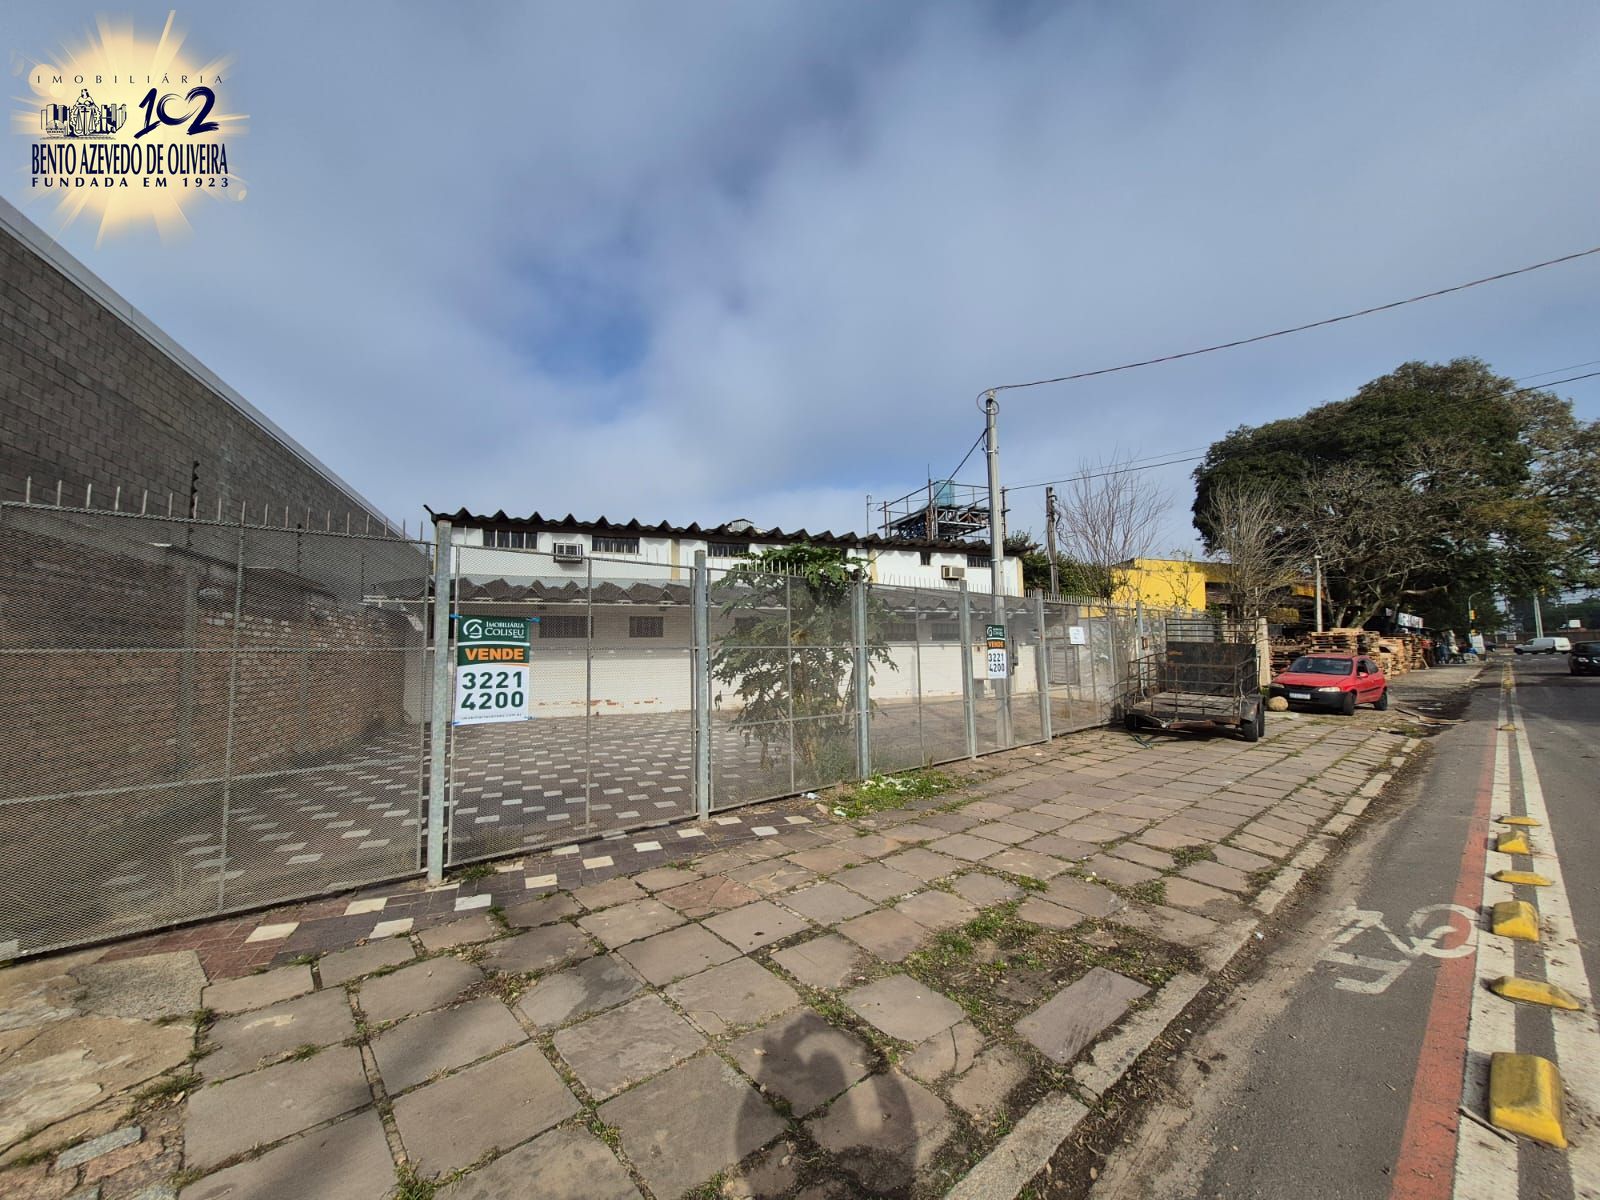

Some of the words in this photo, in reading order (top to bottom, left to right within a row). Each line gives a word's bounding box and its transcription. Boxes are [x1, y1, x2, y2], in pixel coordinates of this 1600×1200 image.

[484, 627, 525, 636] COLISEU
[465, 648, 524, 660] VENDE
[988, 653, 1004, 662] 3221
[989, 664, 1005, 672] 4200
[462, 671, 522, 690] 3221
[461, 691, 524, 711] 4200
